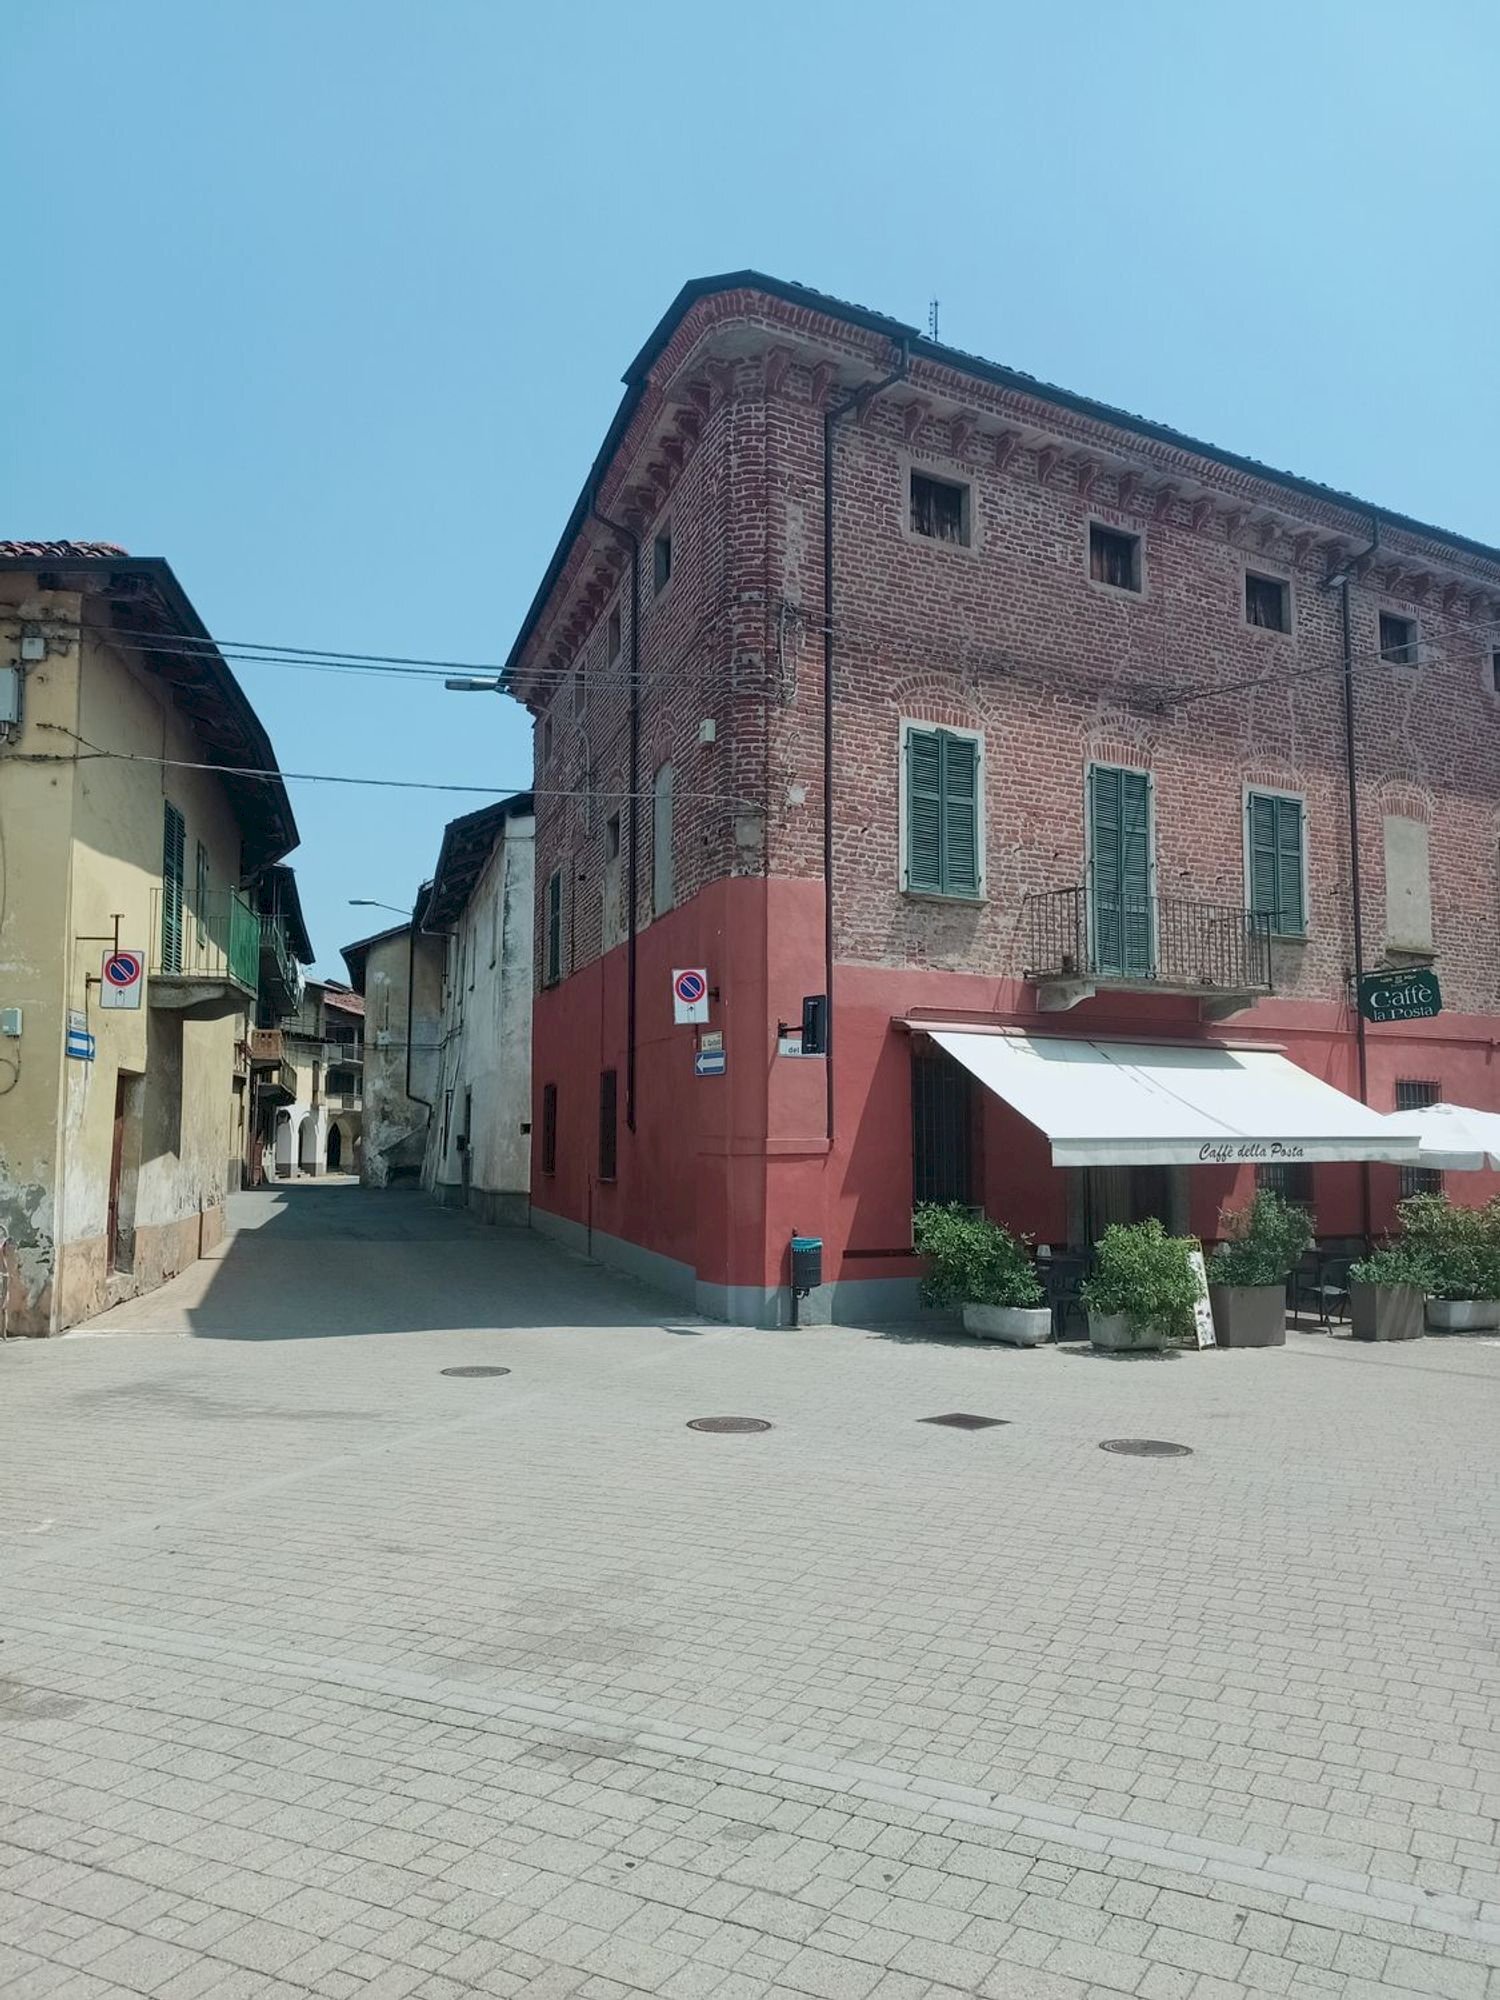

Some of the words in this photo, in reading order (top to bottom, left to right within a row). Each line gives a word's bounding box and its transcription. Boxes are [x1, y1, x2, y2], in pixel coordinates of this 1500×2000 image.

[1370, 984, 1433, 1008] Caffè
[1374, 1009, 1386, 1021] la
[1391, 1006, 1434, 1019] Posta
[1198, 1142, 1234, 1162] Caffè
[1237, 1144, 1267, 1158] della
[1270, 1142, 1304, 1158] Posta
